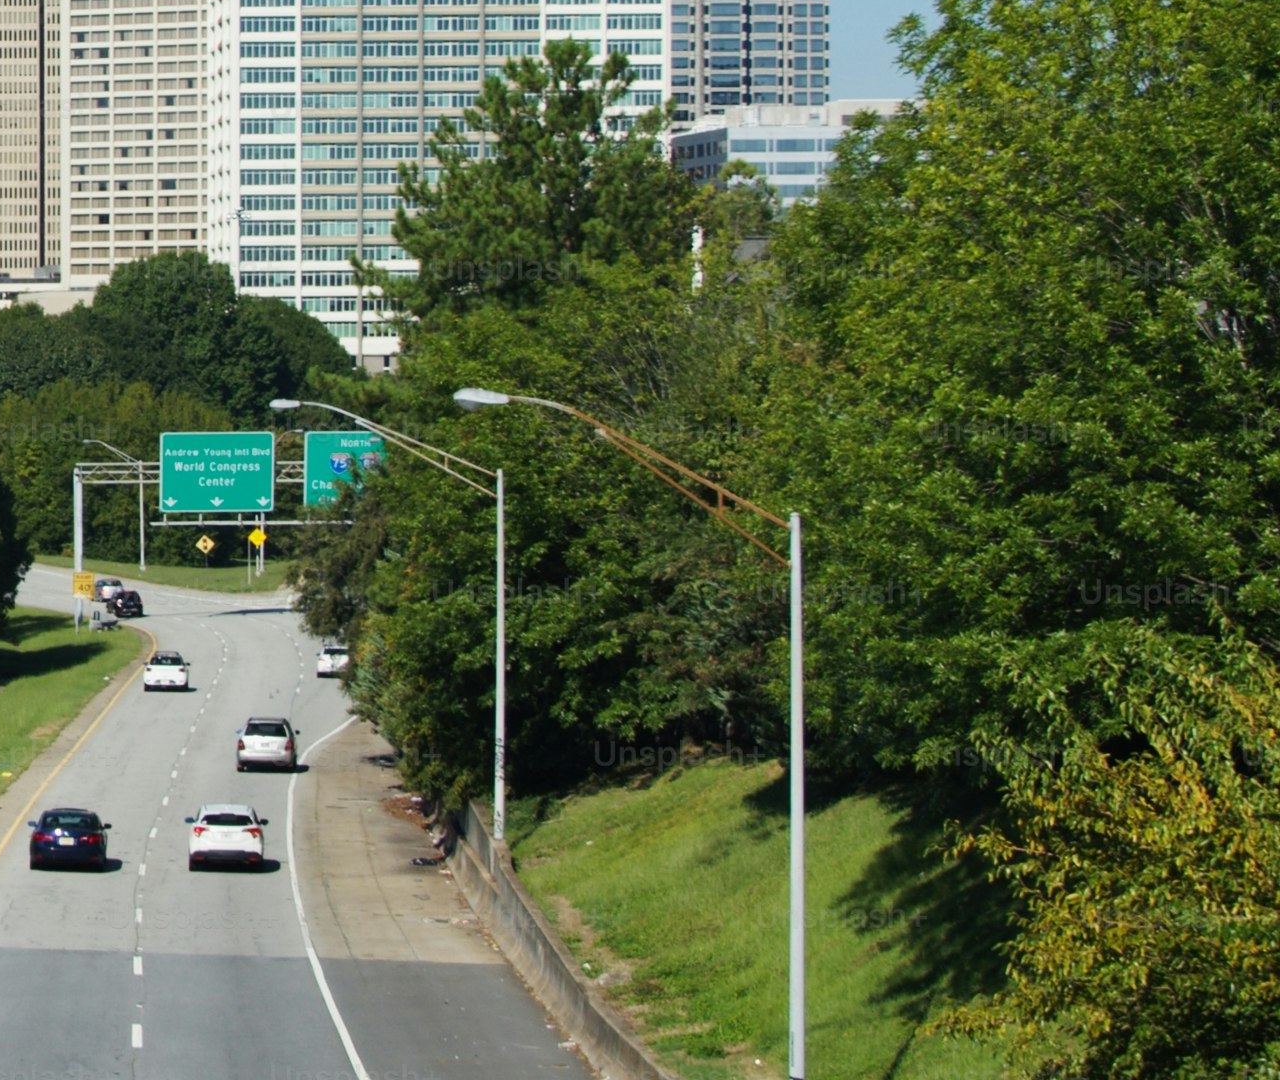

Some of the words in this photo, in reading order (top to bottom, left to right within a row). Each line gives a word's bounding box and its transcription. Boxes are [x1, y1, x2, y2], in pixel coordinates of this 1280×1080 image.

[165, 448, 199, 457] Andrew
[204, 448, 232, 458] Young
[252, 448, 270, 457] Blvd
[174, 462, 204, 471] World
[209, 462, 261, 474] Congress
[332, 458, 347, 469] 75
[198, 477, 236, 487] Center
